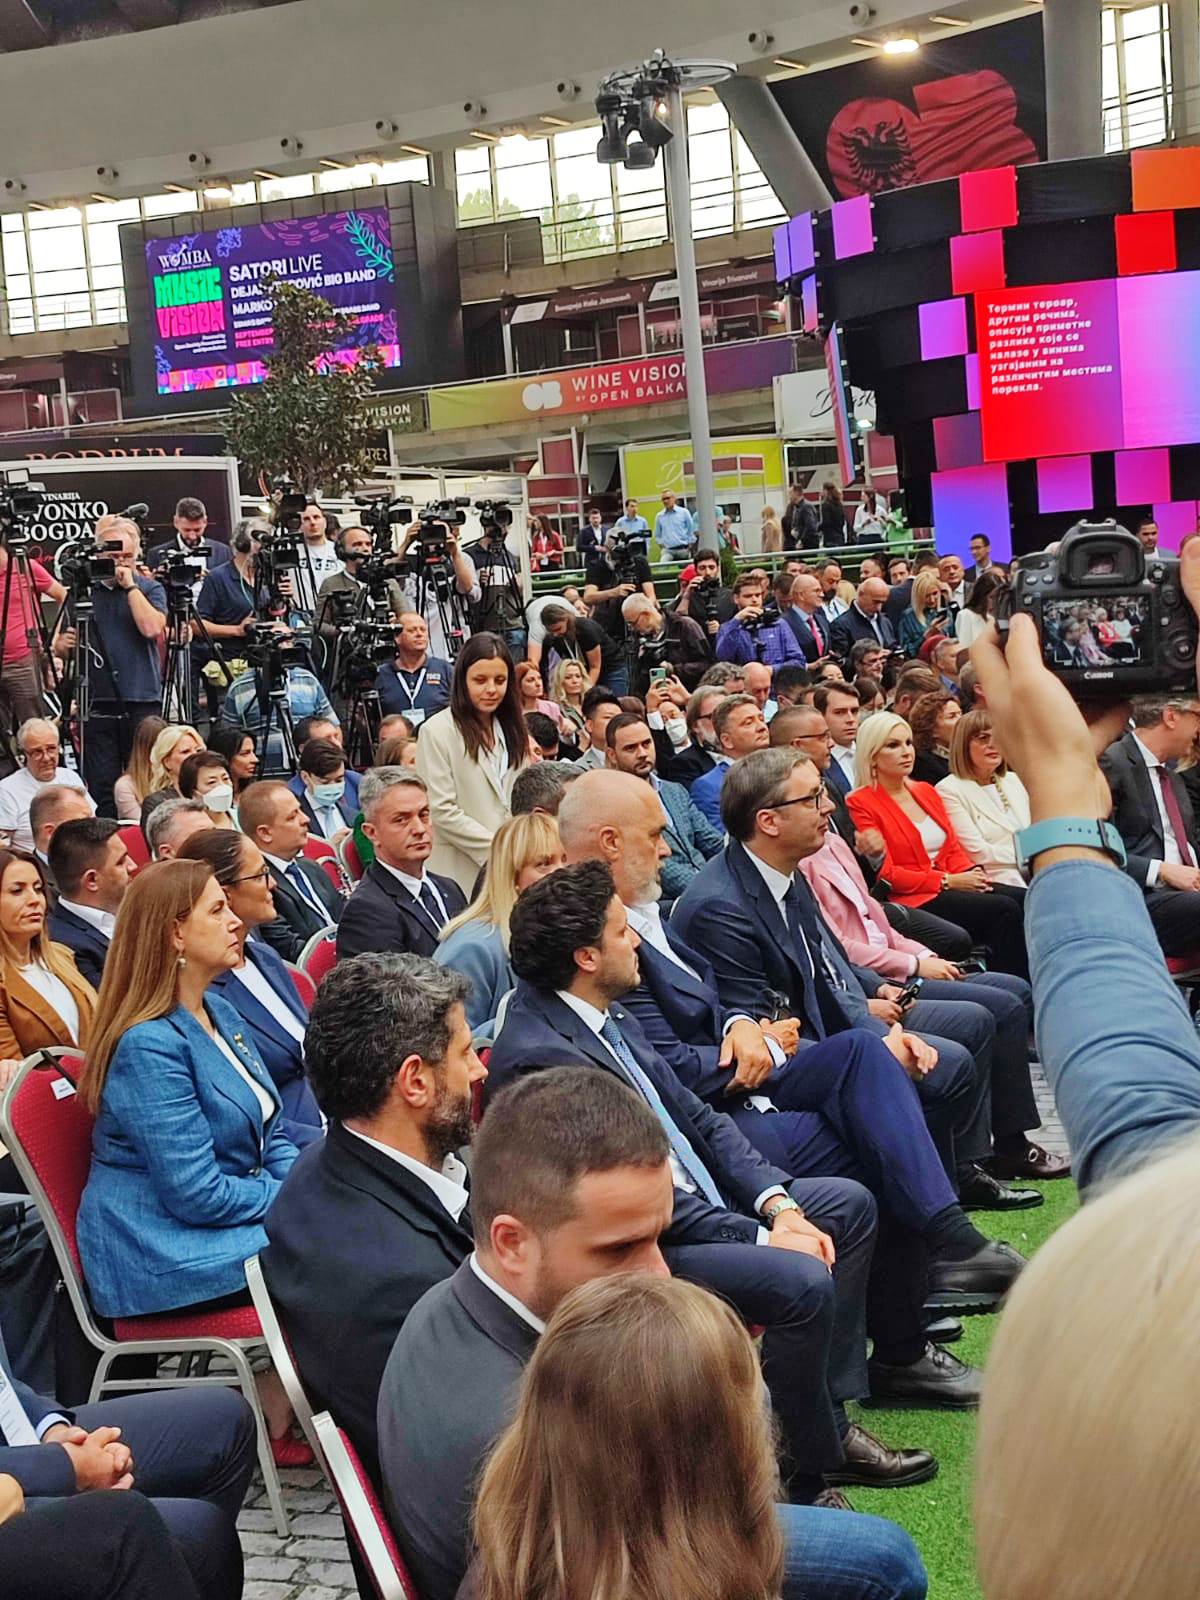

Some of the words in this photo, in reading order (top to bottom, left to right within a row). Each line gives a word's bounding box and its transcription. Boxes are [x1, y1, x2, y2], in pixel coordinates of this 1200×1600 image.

[158, 247, 211, 269] WOMBA
[229, 259, 288, 282] SATORI
[289, 254, 322, 274] LIVE
[323, 274, 343, 286] BIG
[344, 269, 376, 284] BAND
[988, 303, 1030, 314] Термин
[988, 315, 1030, 327] другим
[1033, 310, 1079, 323] речима,
[988, 325, 1033, 337] описује
[1036, 320, 1092, 333] приметне
[989, 337, 1036, 350] разлике
[1039, 333, 1062, 344] које
[1066, 333, 1079, 341] се
[990, 349, 1030, 360] налазе
[1032, 348, 1039, 357] у
[1042, 345, 1084, 355] винима
[990, 359, 1047, 374] узгајаним
[1050, 358, 1064, 366] на
[991, 370, 1059, 384] различитим
[1062, 365, 1113, 377] местима
[571, 371, 622, 391] WINE
[589, 389, 629, 404] OPEN
[635, 381, 685, 398] BALKA
[365, 403, 410, 417] VISION
[32, 501, 109, 522] VONKO
[22, 521, 97, 542] BOGDA
[1083, 671, 1114, 680] Canon
